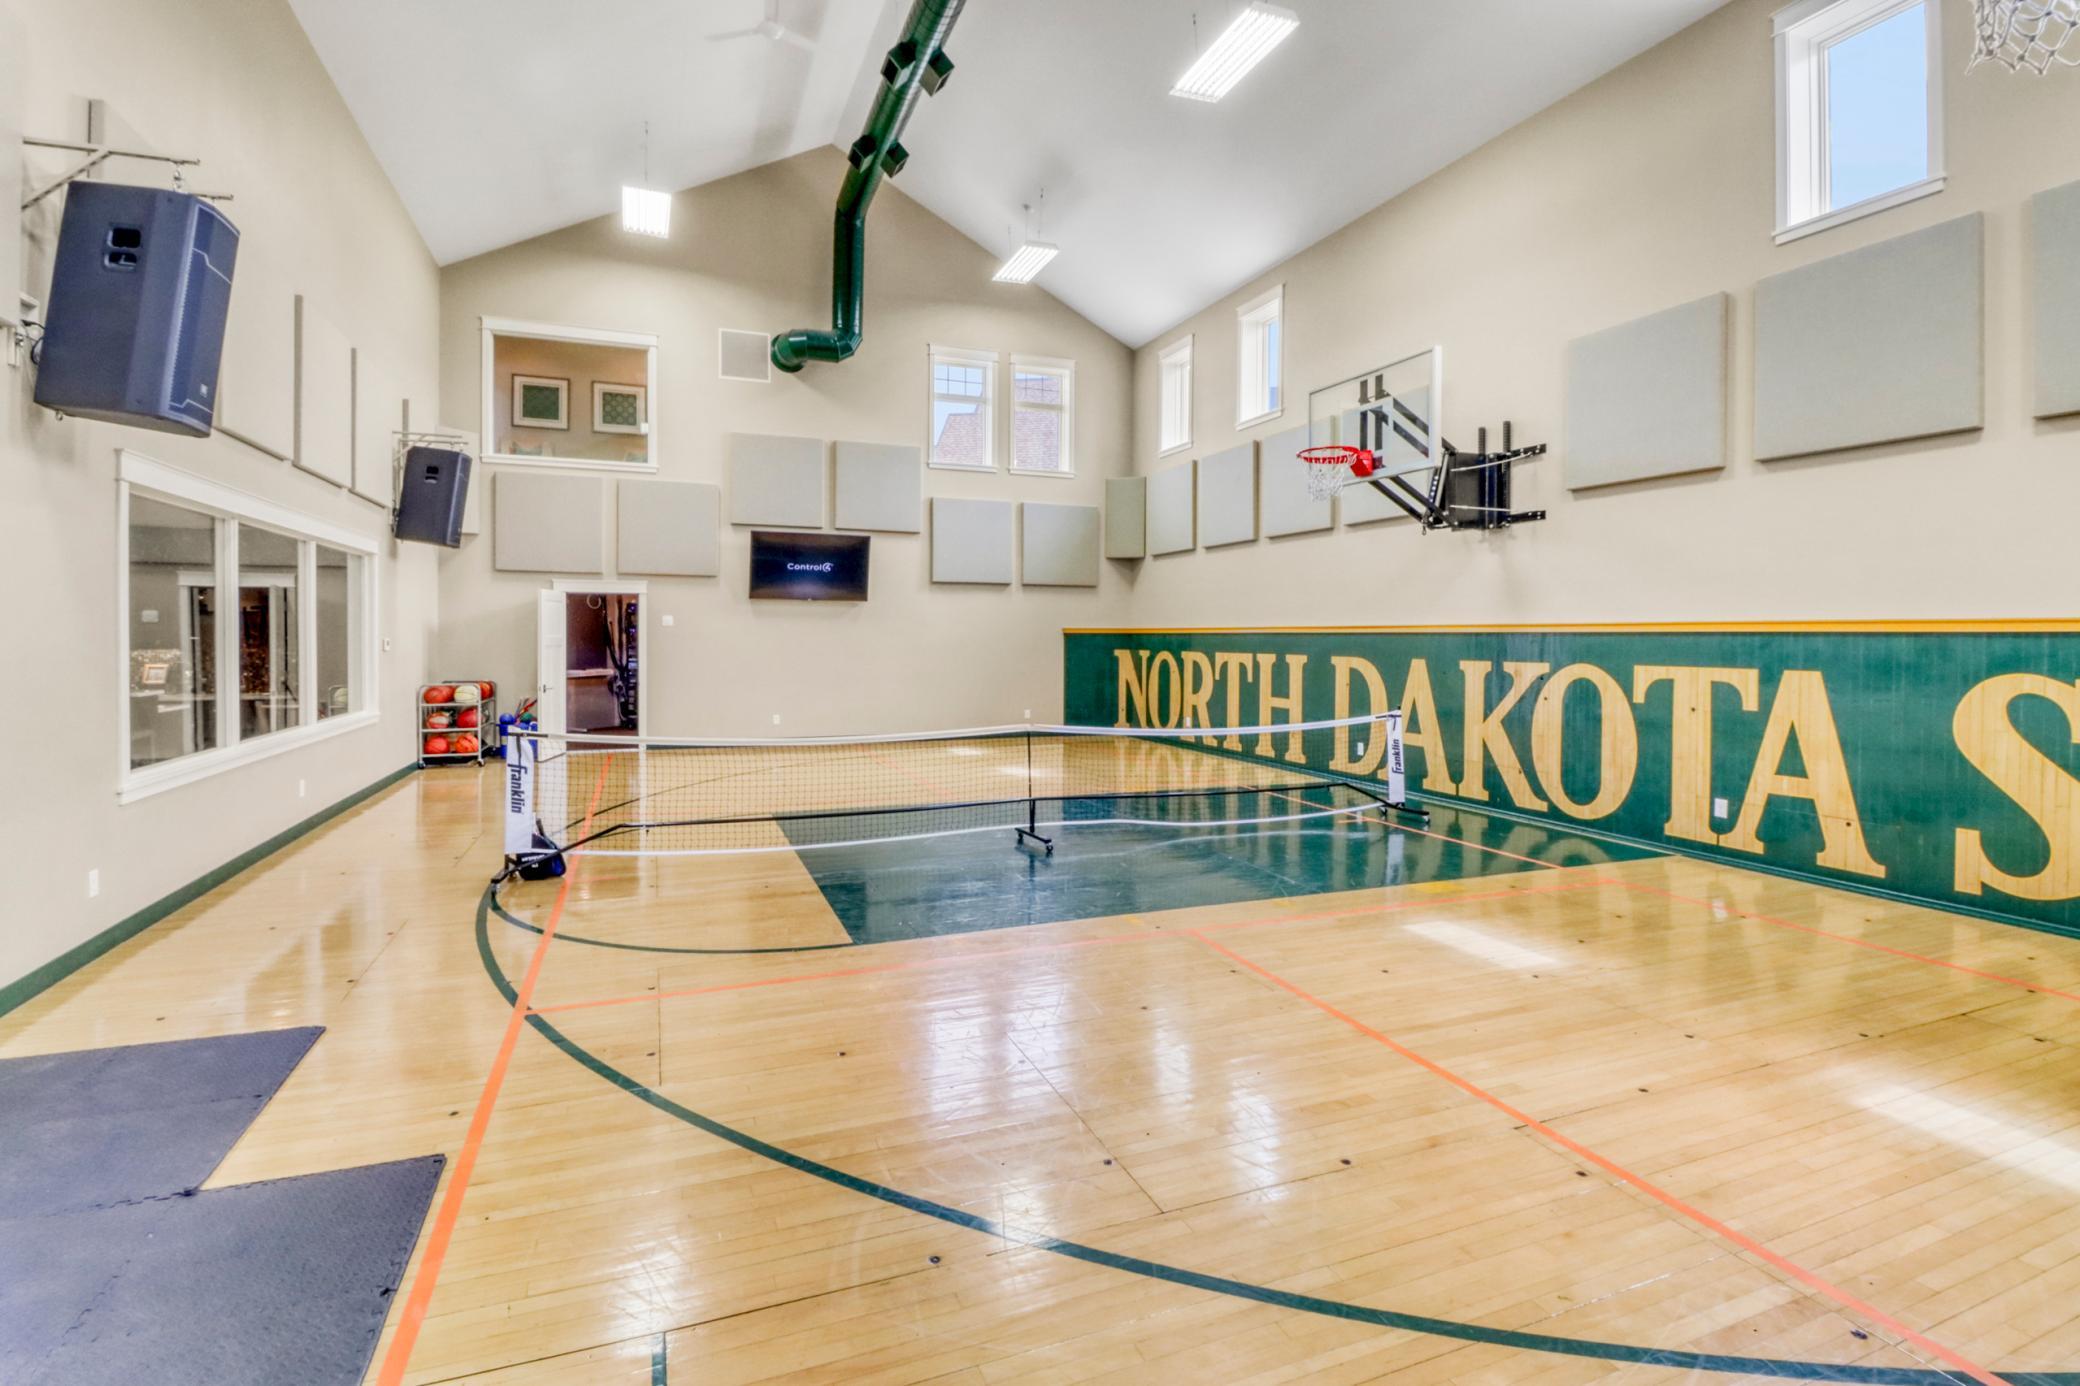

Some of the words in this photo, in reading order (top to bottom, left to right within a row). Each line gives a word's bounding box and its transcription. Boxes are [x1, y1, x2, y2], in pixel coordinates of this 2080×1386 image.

[787, 562, 833, 572] Control4
[1114, 649, 1308, 764] NORTH
[1329, 656, 1886, 879] DAKOTA
